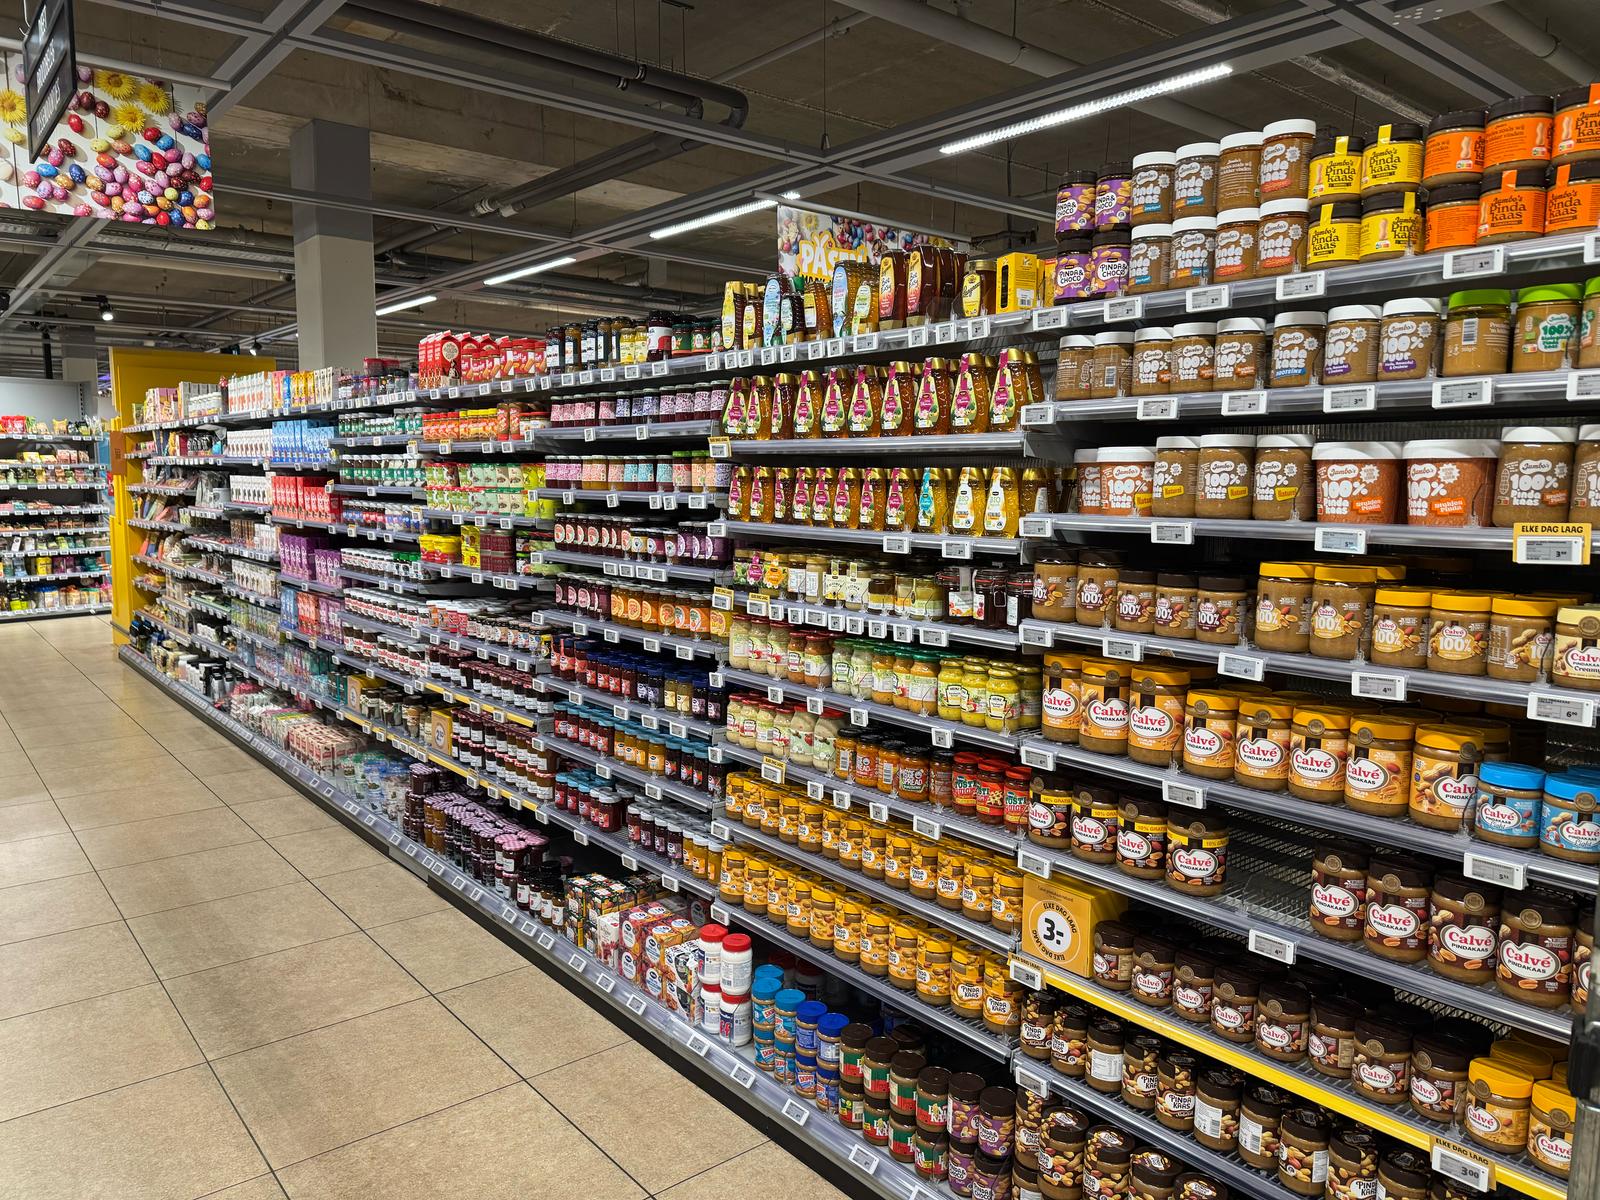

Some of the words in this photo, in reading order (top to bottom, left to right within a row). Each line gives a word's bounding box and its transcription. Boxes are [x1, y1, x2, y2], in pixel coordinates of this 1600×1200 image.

[1369, 156, 1401, 167] Pinda
[1325, 166, 1356, 177] Pinda
[1369, 164, 1398, 175] kaas
[1327, 174, 1354, 182] kaas
[1489, 203, 1527, 214] Pinda
[1491, 212, 1523, 222] kaas
[1311, 233, 1340, 246] Pinda
[1312, 242, 1337, 252] kaas
[1060, 275, 1081, 284] CHOCO
[1382, 335, 1424, 354] 100%
[1138, 360, 1168, 373] 100%
[1178, 355, 1209, 369] 100%
[1216, 352, 1247, 367] 100%
[1204, 472, 1241, 486] 100%
[1510, 474, 1559, 492] 100%
[1321, 480, 1369, 498] 100%
[1521, 525, 1539, 534] ELKE
[1540, 525, 1560, 534] DAG
[1561, 525, 1584, 534] LAAG
[1080, 591, 1104, 605] 100%
[1119, 603, 1142, 616] 100%
[1375, 630, 1402, 644] 100%
[1439, 637, 1472, 652] 100%
[1043, 692, 1072, 708] Calvé
[1093, 703, 1128, 717] Calvé
[1131, 712, 1167, 727] Calvé
[1133, 723, 1163, 733] PINDAKAAS
[1185, 733, 1216, 748] Calvé
[1241, 744, 1278, 758] Calvé
[1244, 752, 1275, 763] PINDAKAAS
[1295, 752, 1332, 768] Calvé
[1347, 763, 1381, 780] Calvé
[1484, 806, 1515, 821] Calvé
[1073, 822, 1102, 836] Calvé
[1565, 825, 1600, 837] Calvé
[1177, 853, 1212, 869] Calvé
[1180, 864, 1210, 873] PINDAKAAS
[1314, 889, 1352, 906] Calvé
[1043, 902, 1055, 910] ELKE
[1317, 899, 1347, 912] PINDAKAAS
[1371, 907, 1412, 925] Calvé
[1373, 919, 1408, 932] PINDAKAAS
[1449, 930, 1493, 946] Calvé
[1451, 943, 1489, 953] PINDAKAAS
[1505, 947, 1552, 968] Calvé
[1507, 959, 1546, 974] PINDAKAAS
[1137, 975, 1160, 987] Calvé
[960, 986, 981, 995] PINDA
[1177, 989, 1199, 1003] Calvé
[988, 998, 1008, 1008] PINDA
[1214, 1008, 1239, 1023] Calvé
[1260, 1026, 1287, 1041] Calvé
[1361, 1067, 1391, 1083] Calvé
[1411, 1080, 1435, 1098] Calvé
[1169, 1095, 1192, 1105] PINDA
[1173, 1102, 1191, 1110] KAAS
[1467, 1108, 1495, 1126] Calvé
[1435, 1139, 1450, 1148] ELKE
[1452, 1143, 1468, 1155] DAG
[1468, 1153, 1489, 1166] LAAG
